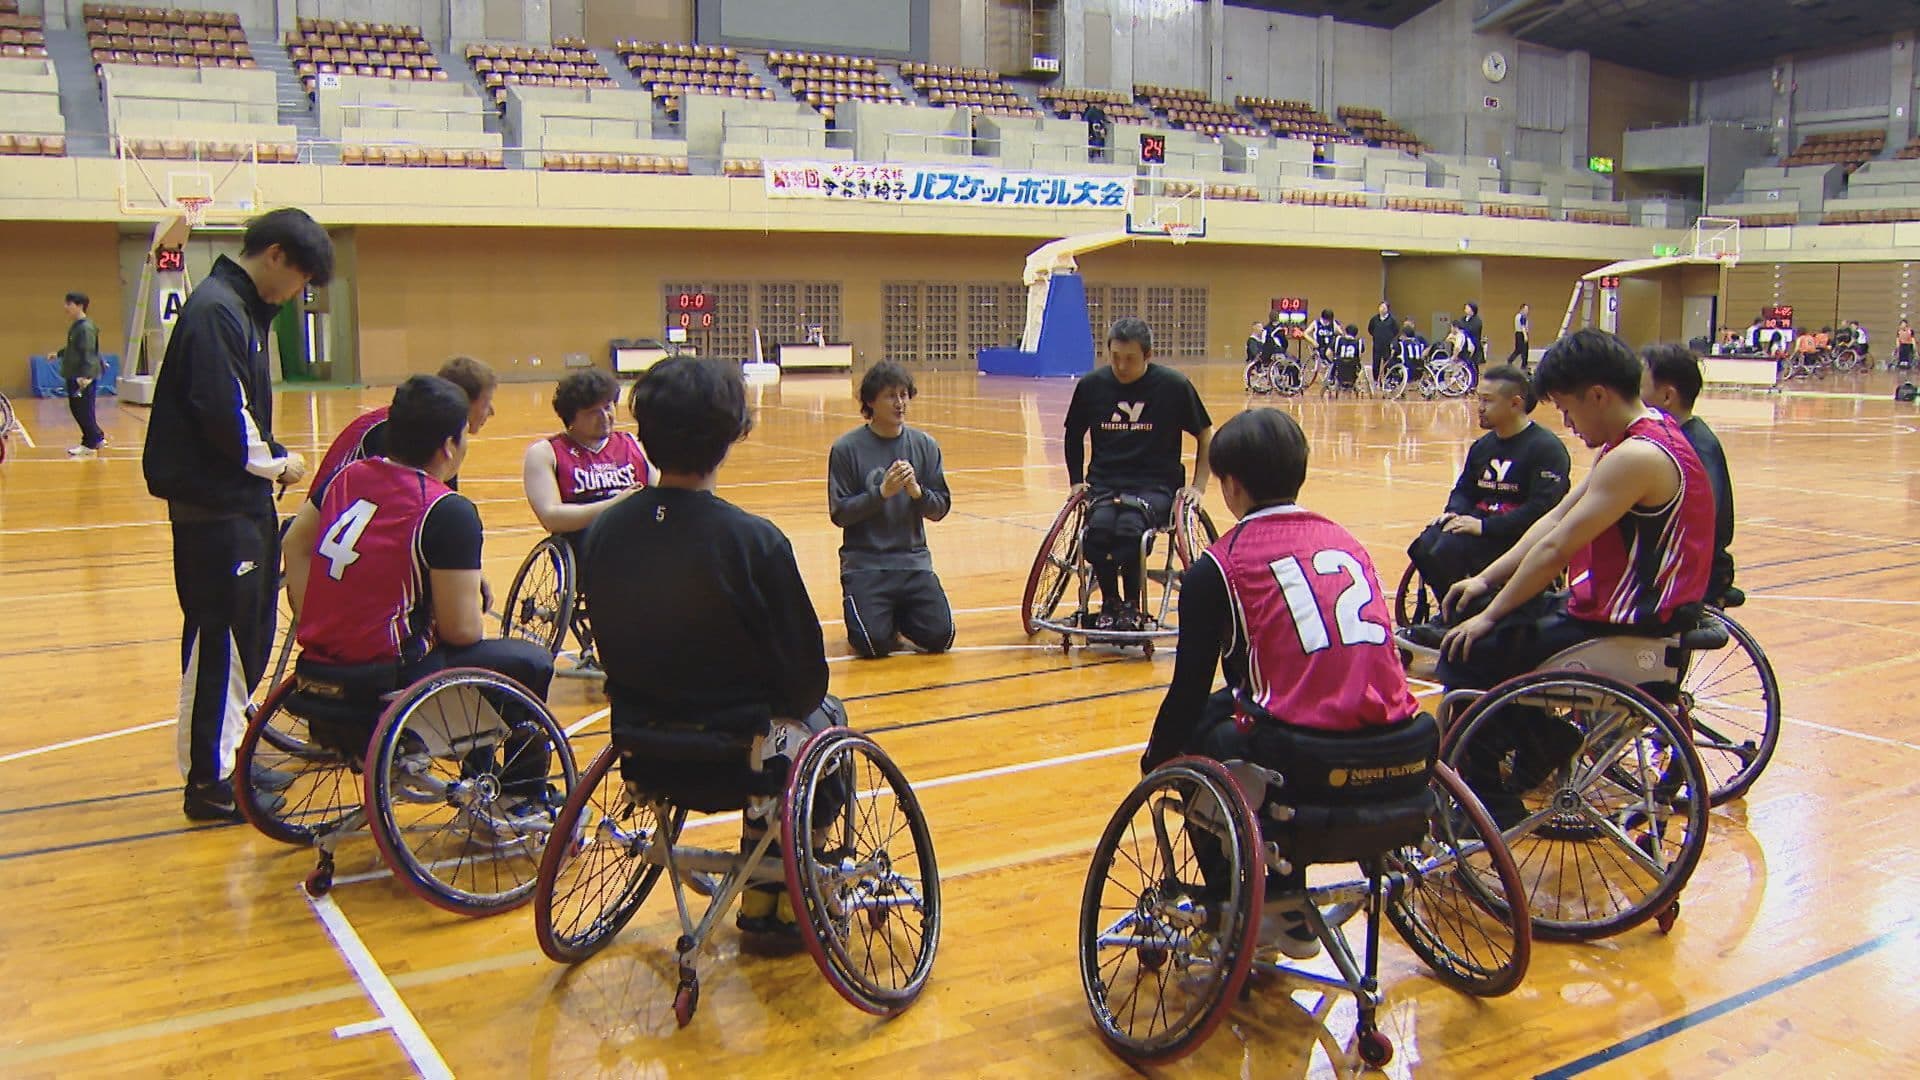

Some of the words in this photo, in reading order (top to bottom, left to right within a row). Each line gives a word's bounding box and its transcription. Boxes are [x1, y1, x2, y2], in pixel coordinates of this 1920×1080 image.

[1144, 139, 1162, 157] 24
[159, 252, 180, 268] 24
[164, 292, 186, 320] A
[681, 313, 689, 326] 0
[703, 313, 711, 326] 0
[1340, 344, 1355, 358] 12
[574, 463, 636, 494] SUNRISE
[655, 506, 666, 521] 5
[317, 497, 380, 581] 4
[1268, 549, 1387, 655] 12
